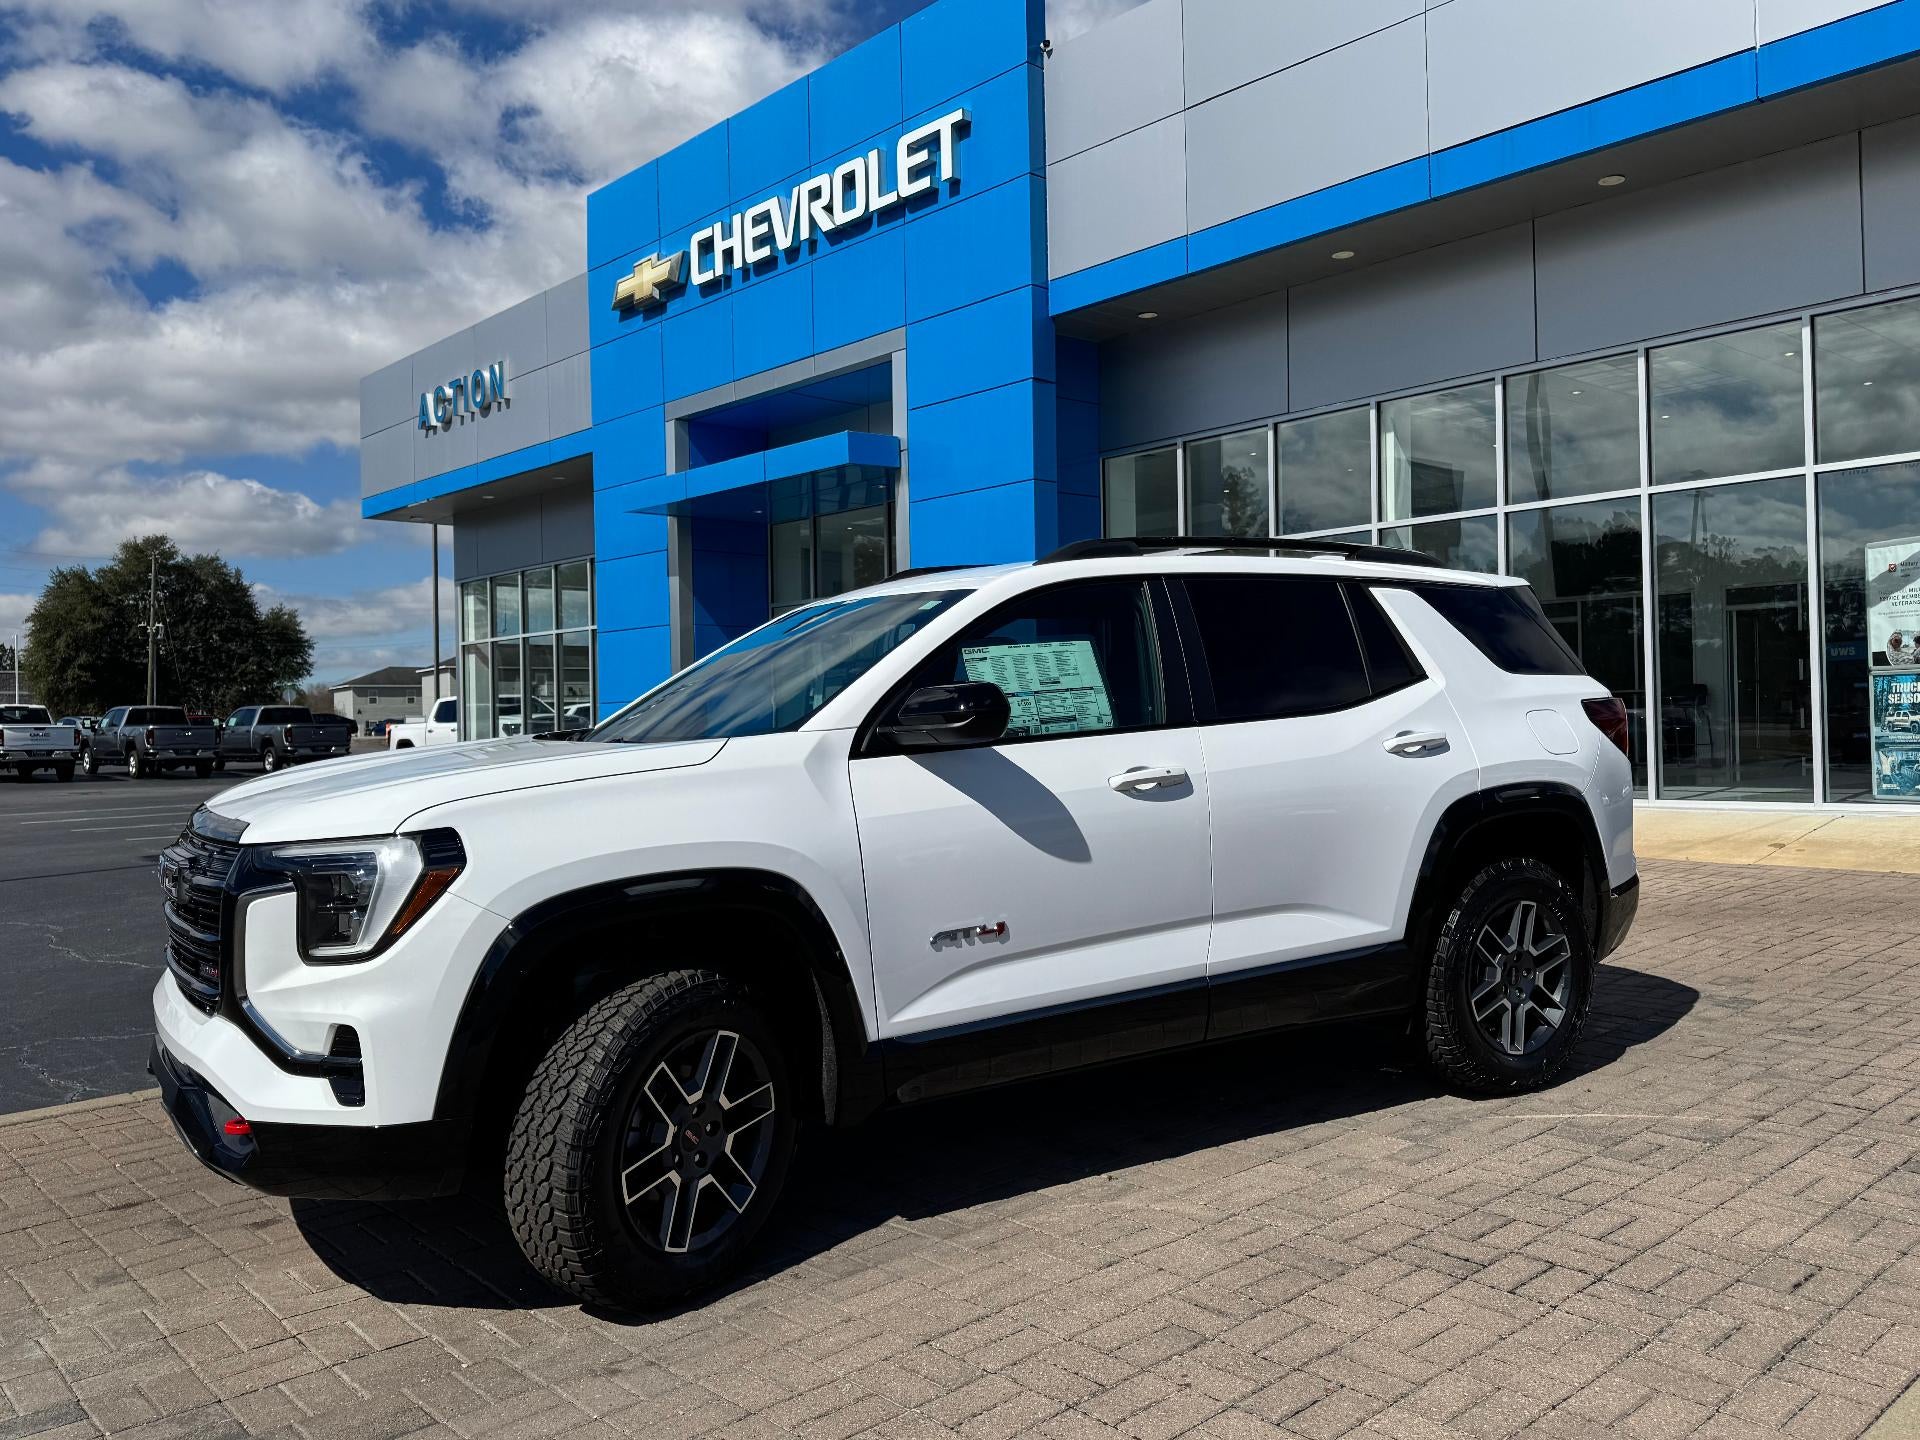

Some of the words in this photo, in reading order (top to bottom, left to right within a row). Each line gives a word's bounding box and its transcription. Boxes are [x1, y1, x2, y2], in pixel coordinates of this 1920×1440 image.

[690, 107, 969, 286] CHEVROLET
[418, 360, 509, 431] ACTION
[964, 647, 989, 655] GMC
[1831, 646, 1856, 657] UWS
